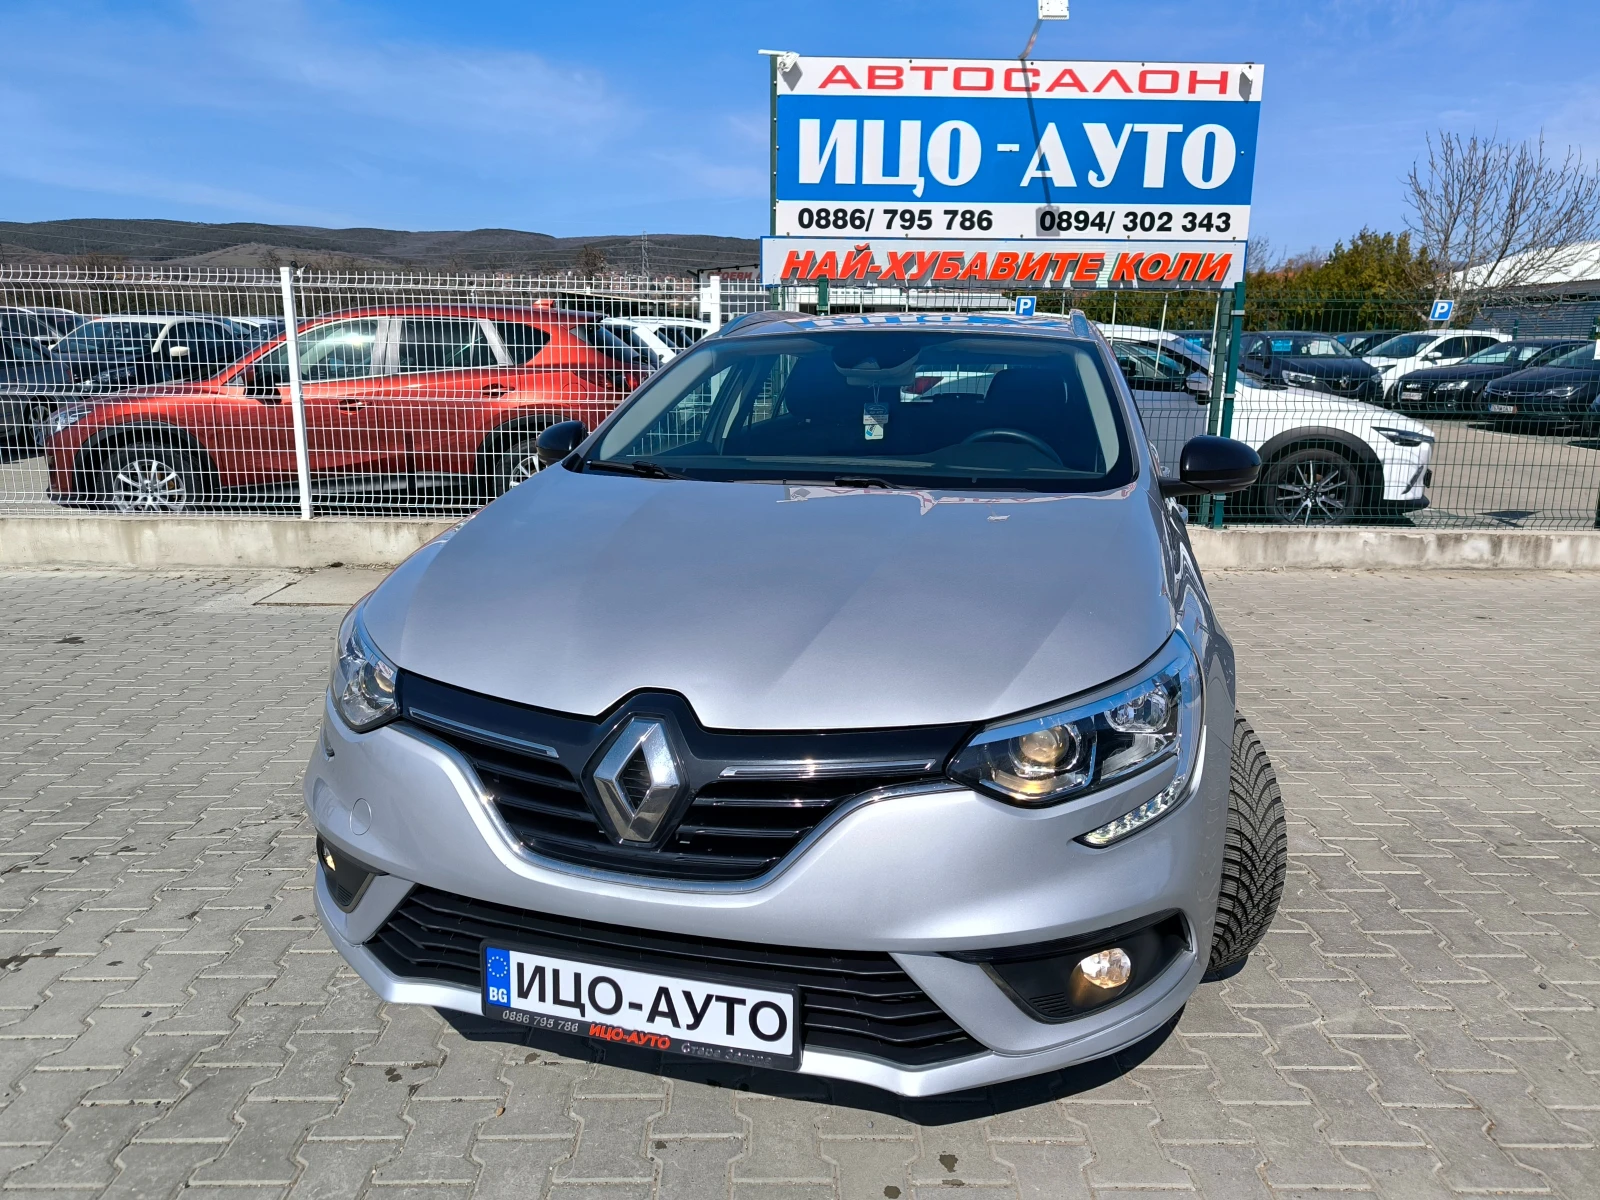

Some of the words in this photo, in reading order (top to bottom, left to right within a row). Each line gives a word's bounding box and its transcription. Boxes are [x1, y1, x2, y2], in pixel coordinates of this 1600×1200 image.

[818, 64, 1229, 95] АВТОСАЛОН
[798, 207, 874, 232] 0886/
[883, 208, 933, 231] 795
[943, 209, 993, 231] 786
[1040, 210, 1115, 234] 0894/
[1122, 211, 1173, 232] 302
[1181, 211, 1231, 233] 343
[781, 242, 1106, 282] НАЙ-ХУБАВИТЕ
[1110, 251, 1234, 283] КОЛИ
[489, 987, 508, 1003] BG
[516, 961, 788, 1042] ИЦО-АУТО
[502, 1010, 530, 1024] 0886
[533, 1016, 554, 1028] 795
[557, 1020, 579, 1033] 786
[588, 1022, 671, 1050] ИЦО-АУТО
